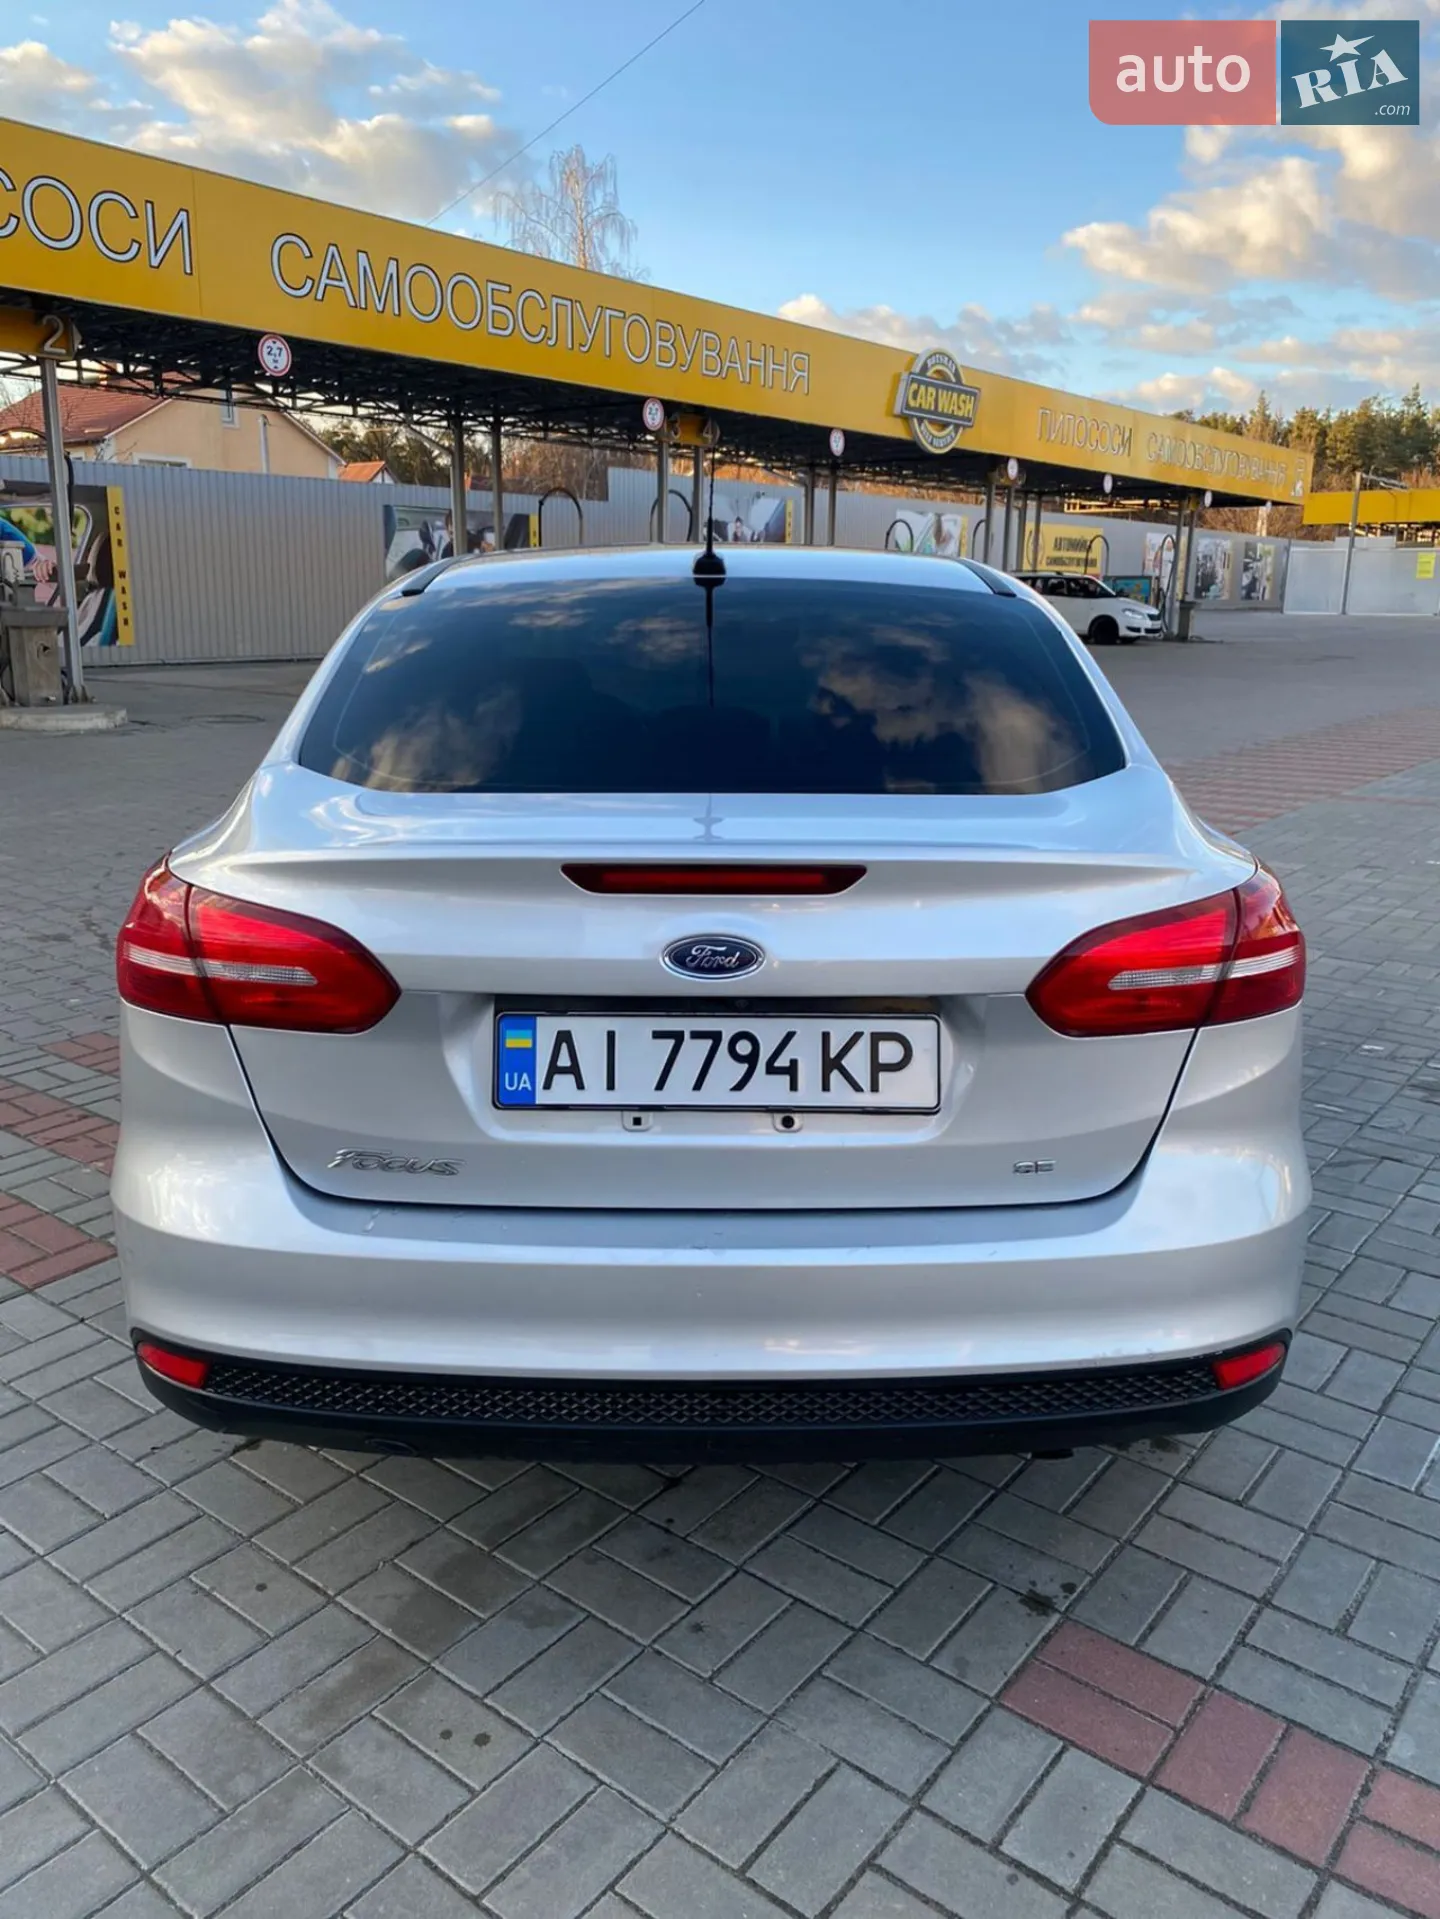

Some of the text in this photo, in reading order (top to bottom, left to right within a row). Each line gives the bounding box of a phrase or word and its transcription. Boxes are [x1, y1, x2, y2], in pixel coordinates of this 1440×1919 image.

[270, 232, 811, 395] САМООБСЛУГОВУВАННЯ
[42, 314, 67, 354] 2
[907, 382, 975, 418] CAR WASH
[1036, 407, 1133, 457] ПИЛОСОСИ
[685, 944, 741, 968] Ford
[542, 1029, 914, 1093] AI 7794 KP
[504, 1072, 532, 1092] UA
